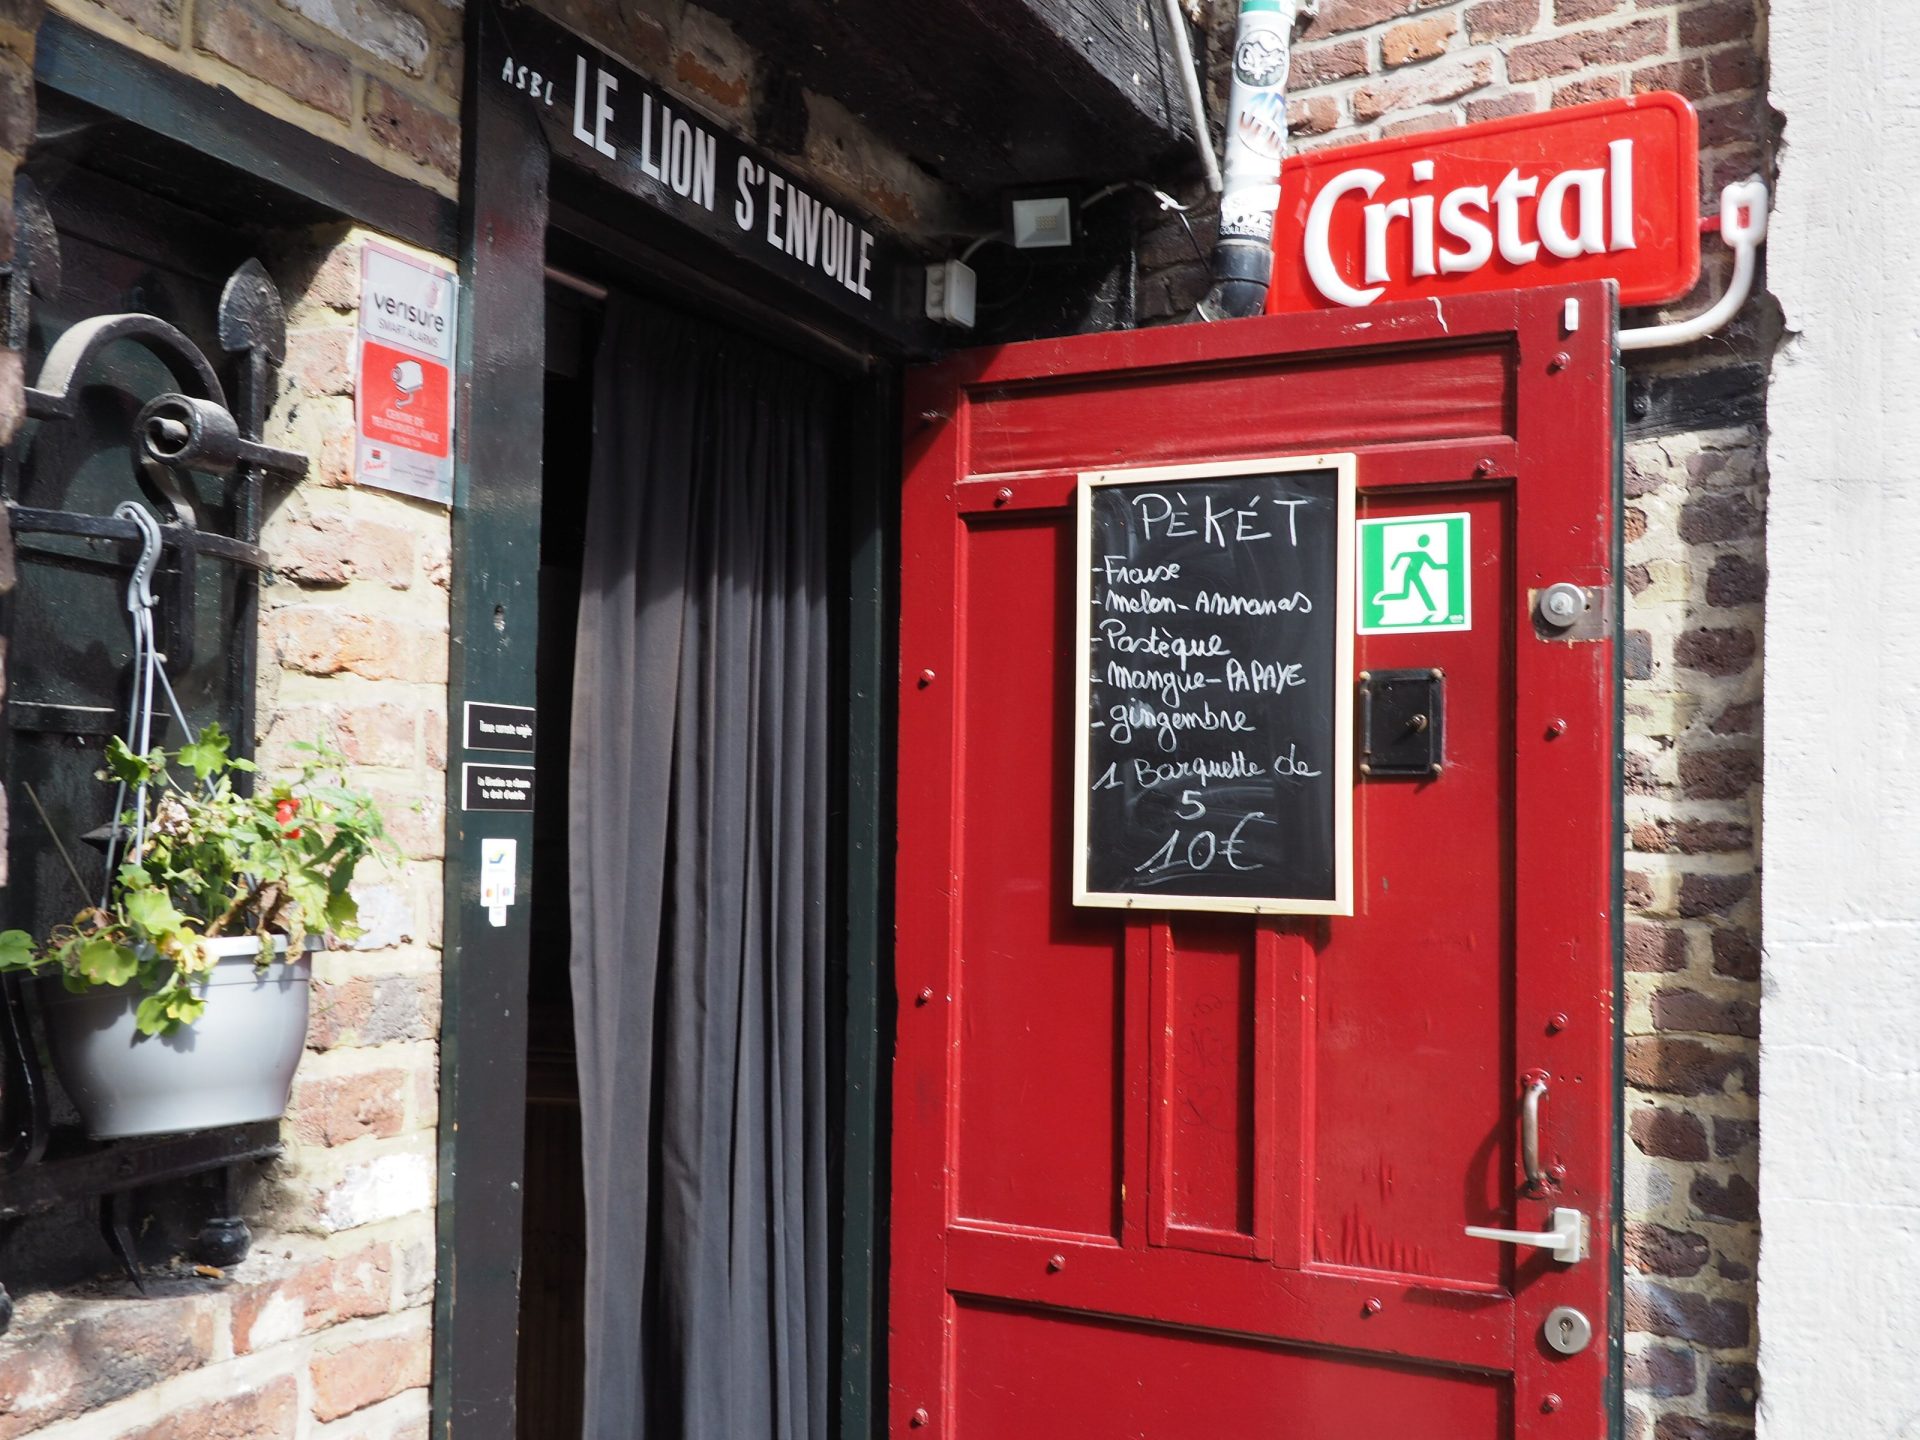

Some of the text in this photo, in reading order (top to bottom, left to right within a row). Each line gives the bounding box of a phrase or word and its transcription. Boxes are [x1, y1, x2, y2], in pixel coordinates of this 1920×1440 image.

[502, 56, 553, 107] ASBL
[573, 54, 875, 301] LE LION S'ENVOILE
[1303, 138, 1638, 307] Cristal
[1091, 761, 1124, 791] 1
[1274, 743, 1322, 777] de
[1174, 789, 1206, 821] 5
